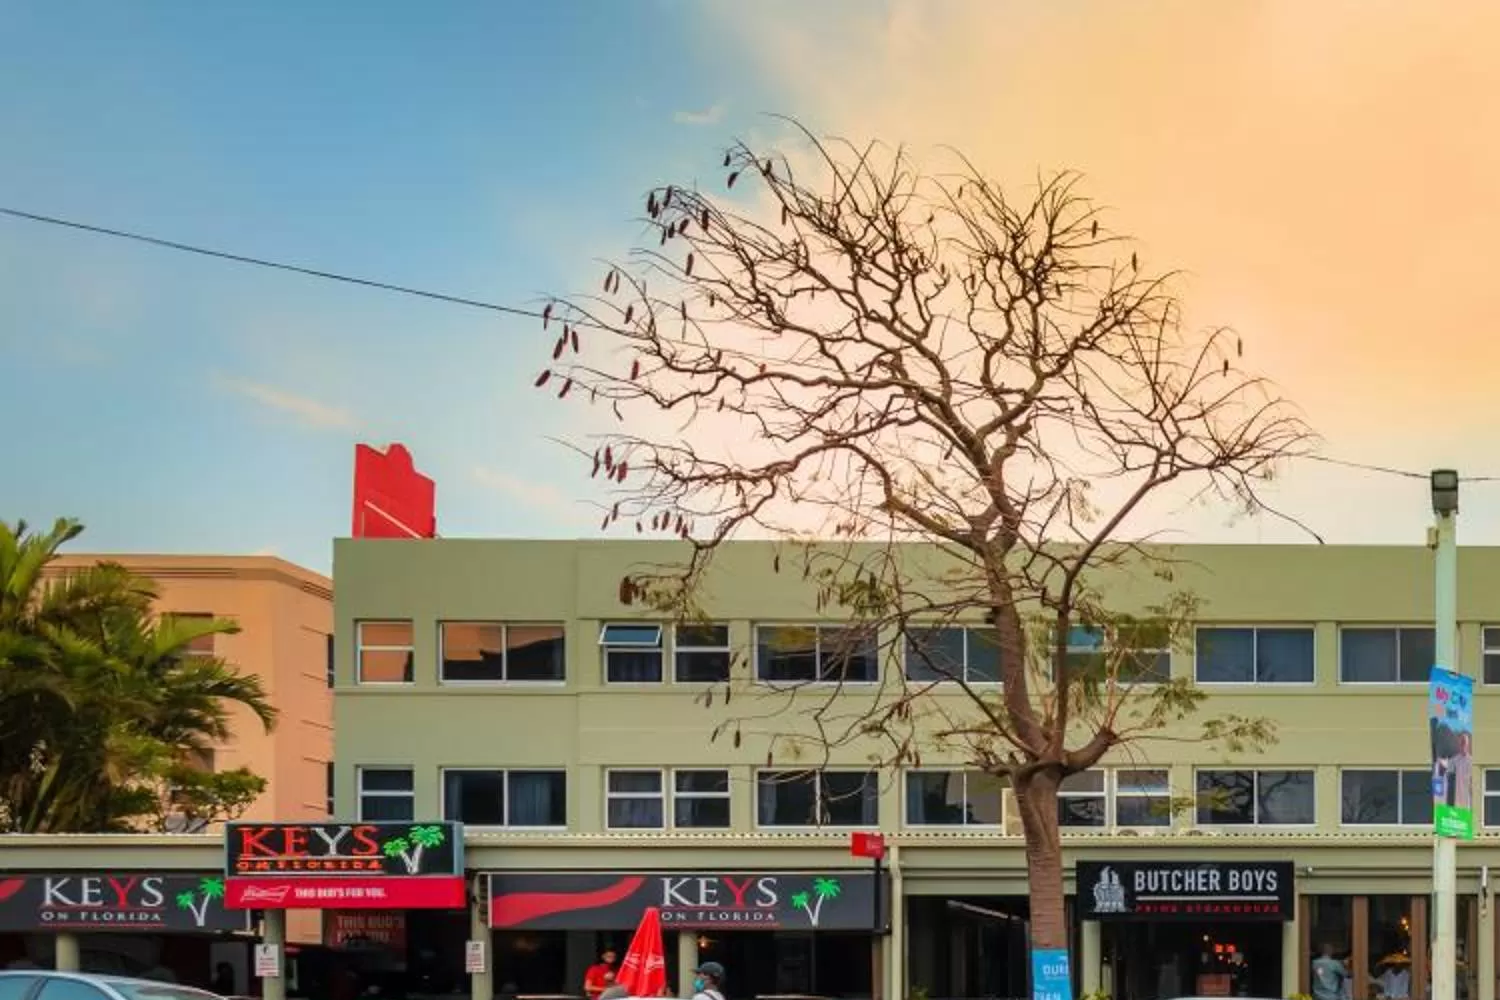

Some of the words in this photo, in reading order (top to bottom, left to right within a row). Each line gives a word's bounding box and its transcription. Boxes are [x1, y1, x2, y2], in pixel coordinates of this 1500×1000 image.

[237, 825, 379, 858] KEYS
[236, 860, 270, 870] ON
[277, 860, 382, 870] FLORIDA
[43, 876, 165, 908] KEYS
[1134, 869, 1221, 892] BUTCHER
[1229, 869, 1278, 892] BOYS
[660, 877, 779, 908] KEYS
[41, 911, 68, 921] ON
[80, 911, 161, 921] FLORIDA
[661, 911, 687, 921] ON
[697, 911, 775, 921] FLORIDA
